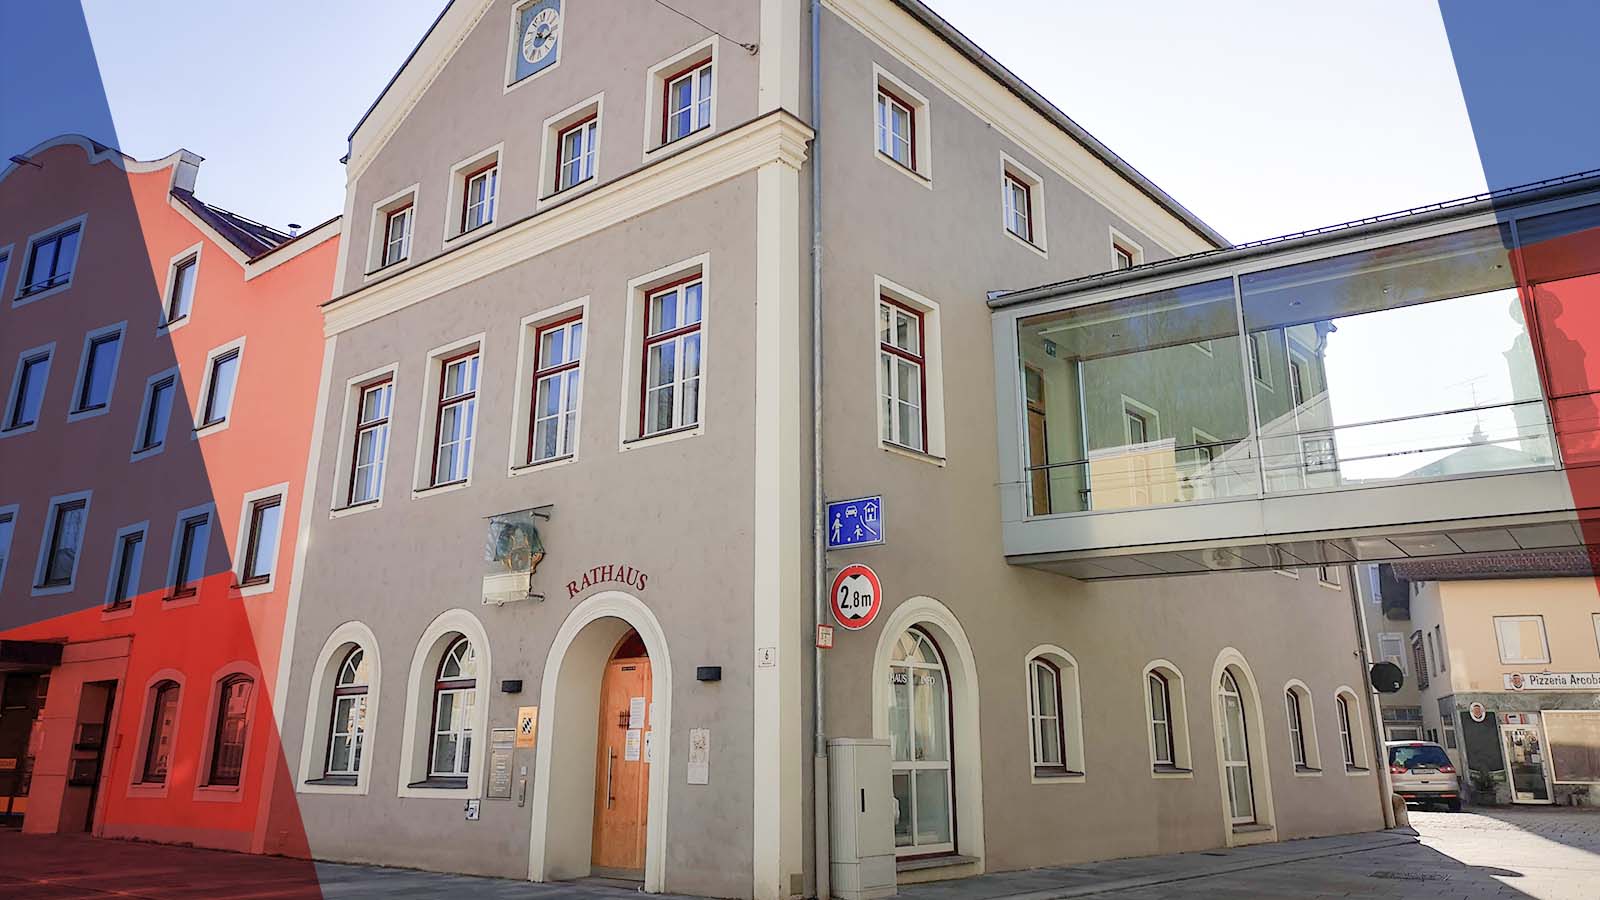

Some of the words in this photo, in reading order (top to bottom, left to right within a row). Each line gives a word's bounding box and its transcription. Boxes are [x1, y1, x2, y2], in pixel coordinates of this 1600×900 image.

[566, 564, 648, 599] RATHAUS
[764, 649, 769, 660] 6
[1529, 674, 1567, 685] Pizzeria
